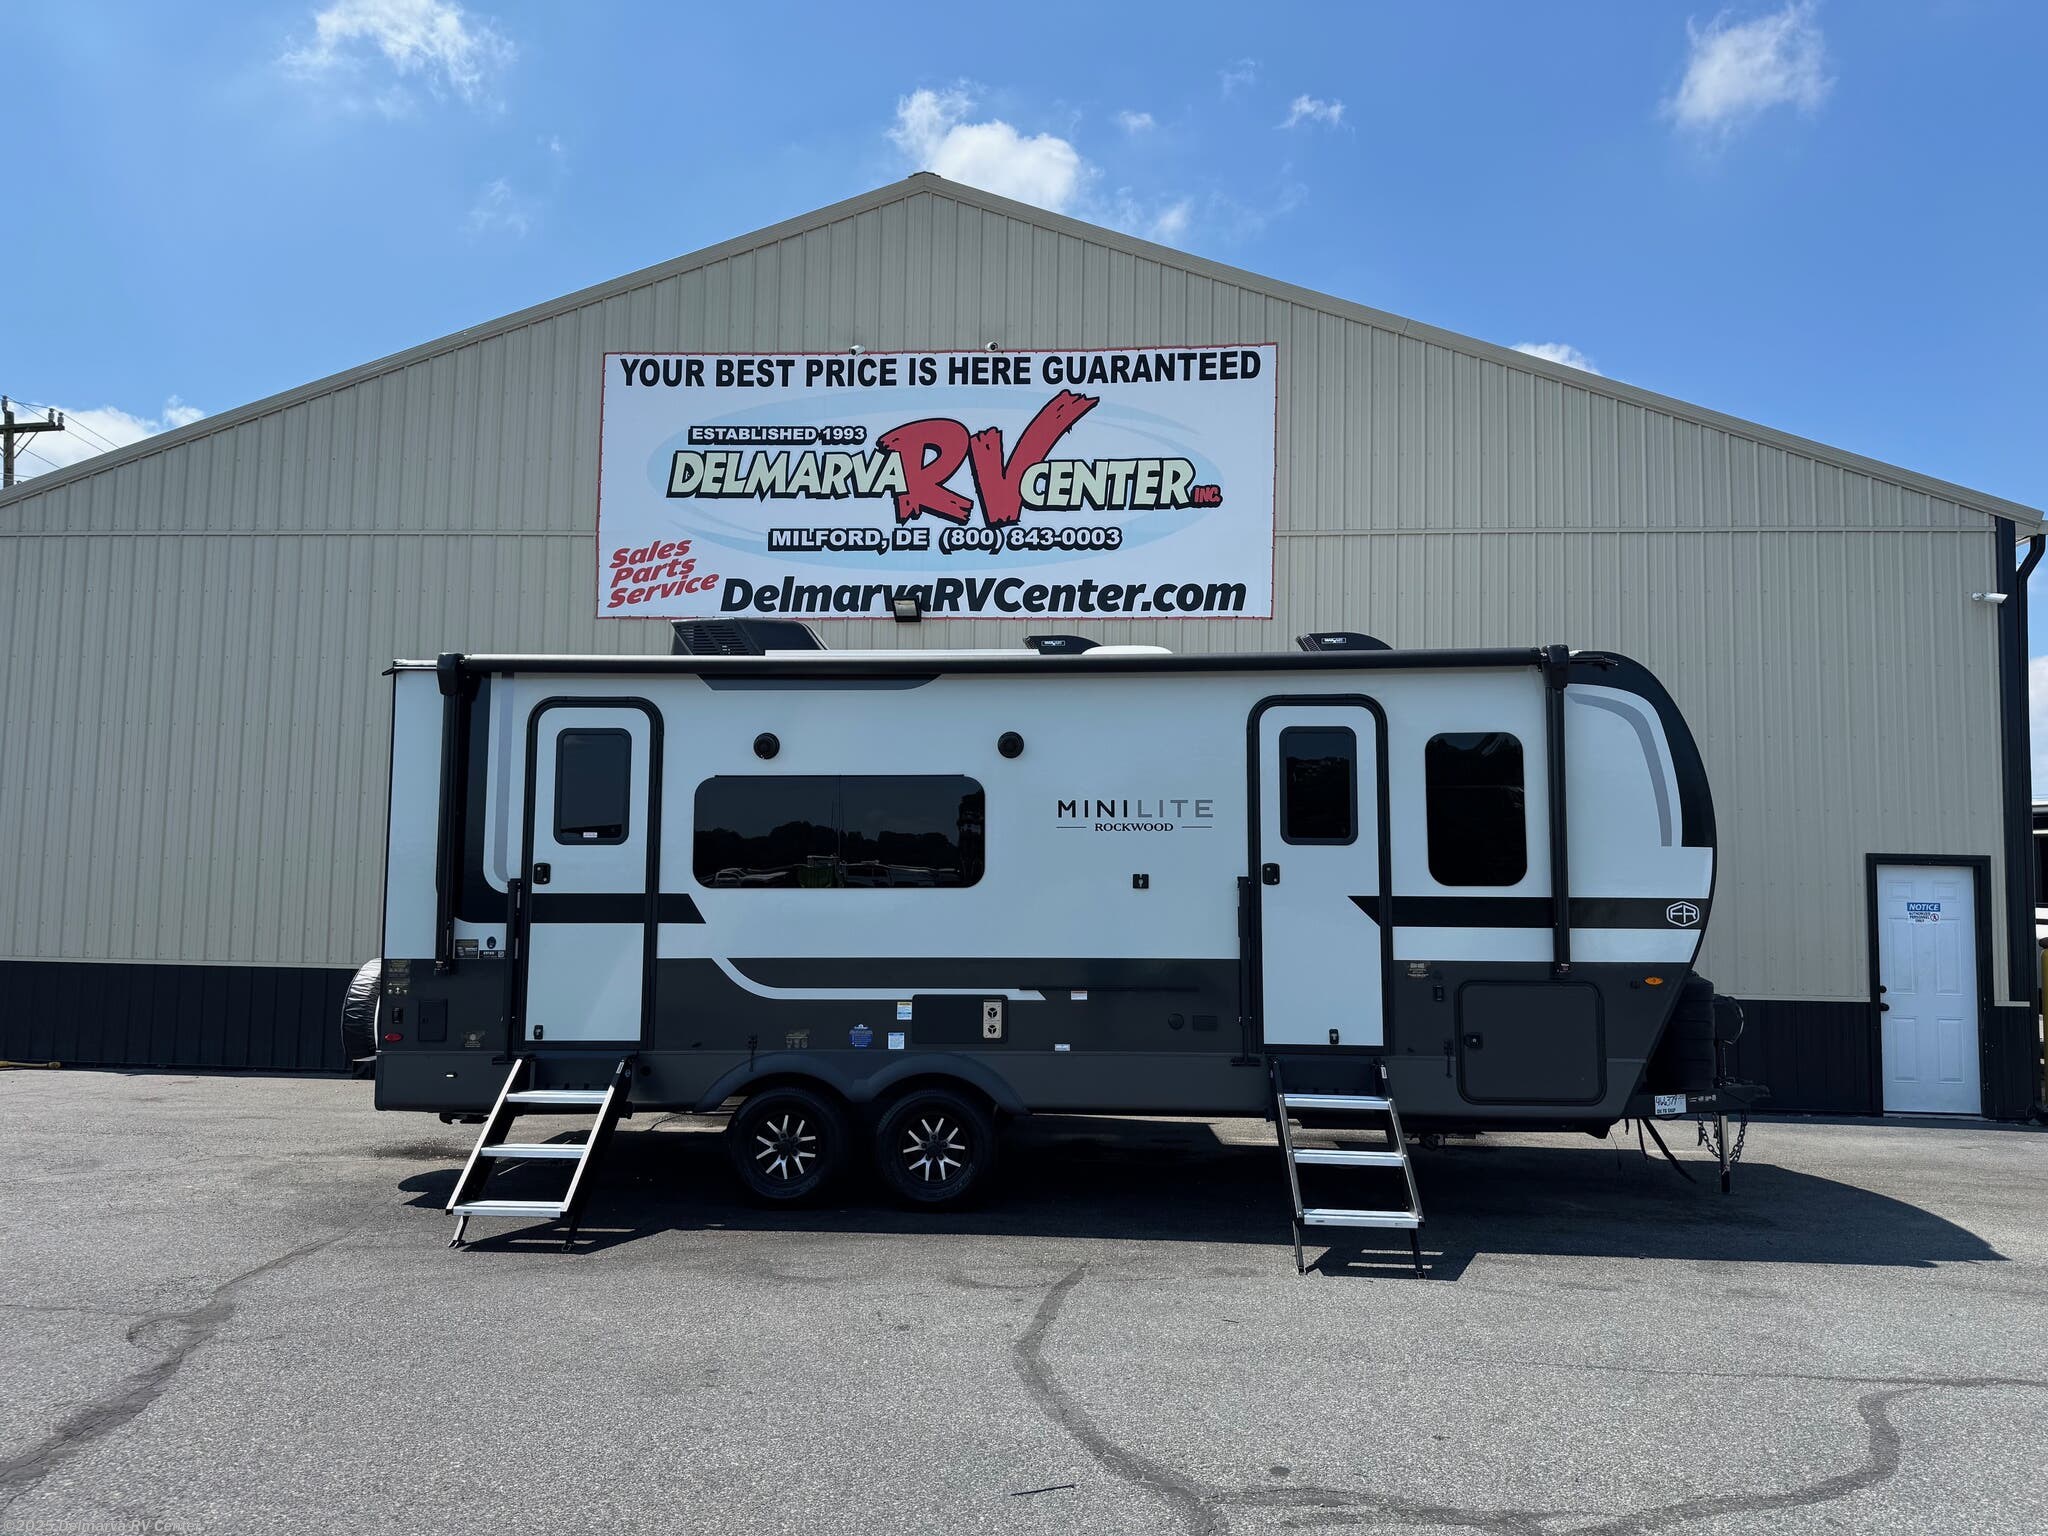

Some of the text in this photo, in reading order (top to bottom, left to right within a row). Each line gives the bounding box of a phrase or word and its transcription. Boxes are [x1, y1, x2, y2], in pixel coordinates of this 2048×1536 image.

[620, 351, 1261, 387] YOUR BEST PRICE IS HERE GUARANTEED
[691, 427, 866, 441] ESTABLISHED 1993
[669, 451, 909, 497] DELMARVA
[876, 389, 1100, 526] RV
[1019, 459, 1196, 508] CENTER
[772, 529, 1122, 551] MILFORD, DE (800) 843-0003
[609, 539, 692, 569] Sales
[610, 557, 697, 588] Parts
[1094, 822, 1174, 832] ROCKWOOD
[1908, 903, 1940, 911] NOTICE
